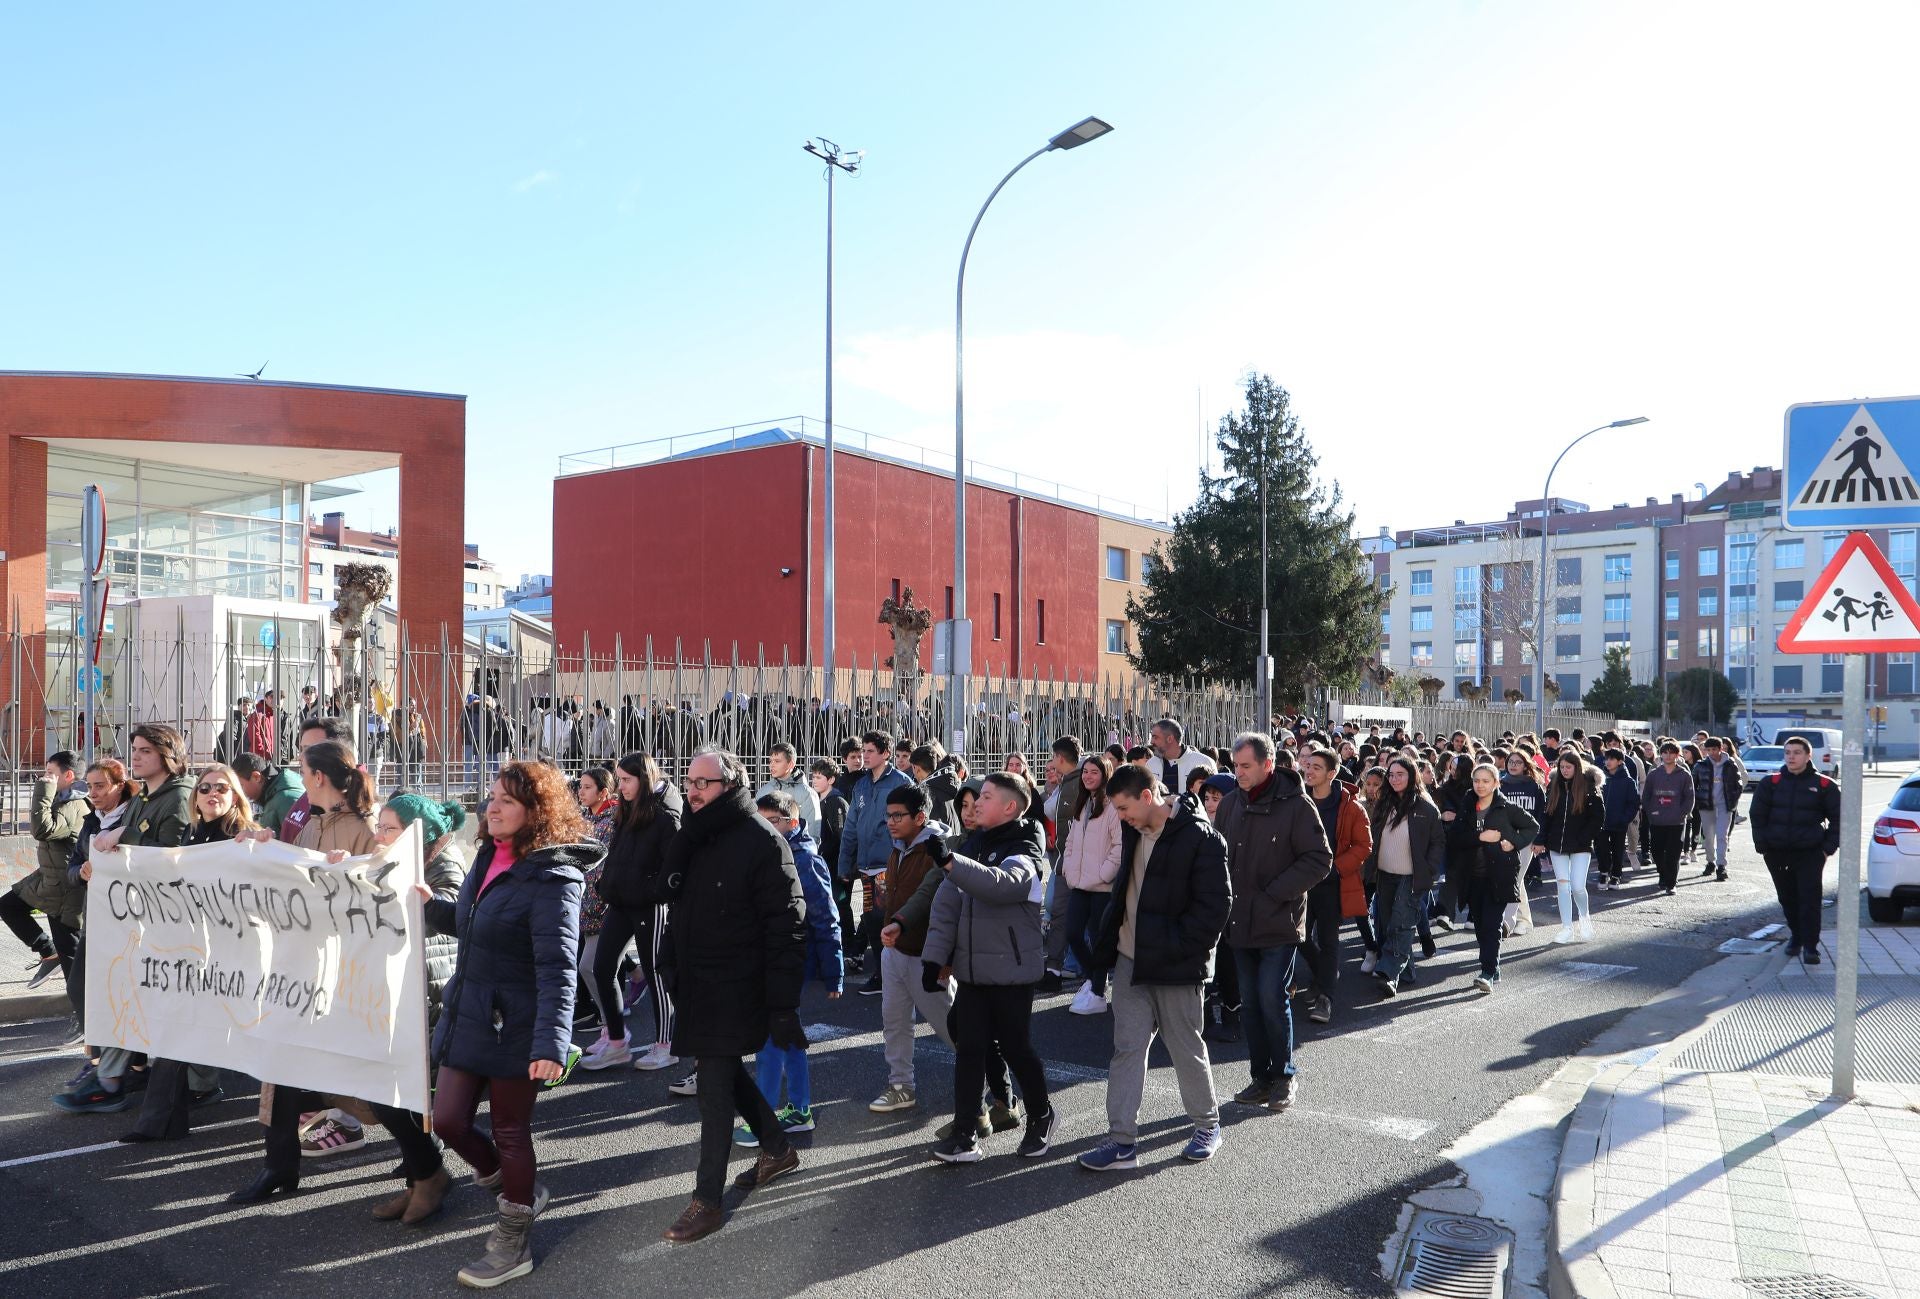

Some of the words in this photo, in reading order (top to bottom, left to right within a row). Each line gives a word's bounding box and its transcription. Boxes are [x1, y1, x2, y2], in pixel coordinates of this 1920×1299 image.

[108, 878, 312, 938] CONSTRUYENDO
[308, 861, 406, 938] PAZ
[140, 956, 170, 991] IES
[253, 972, 327, 1018] ARROYO
